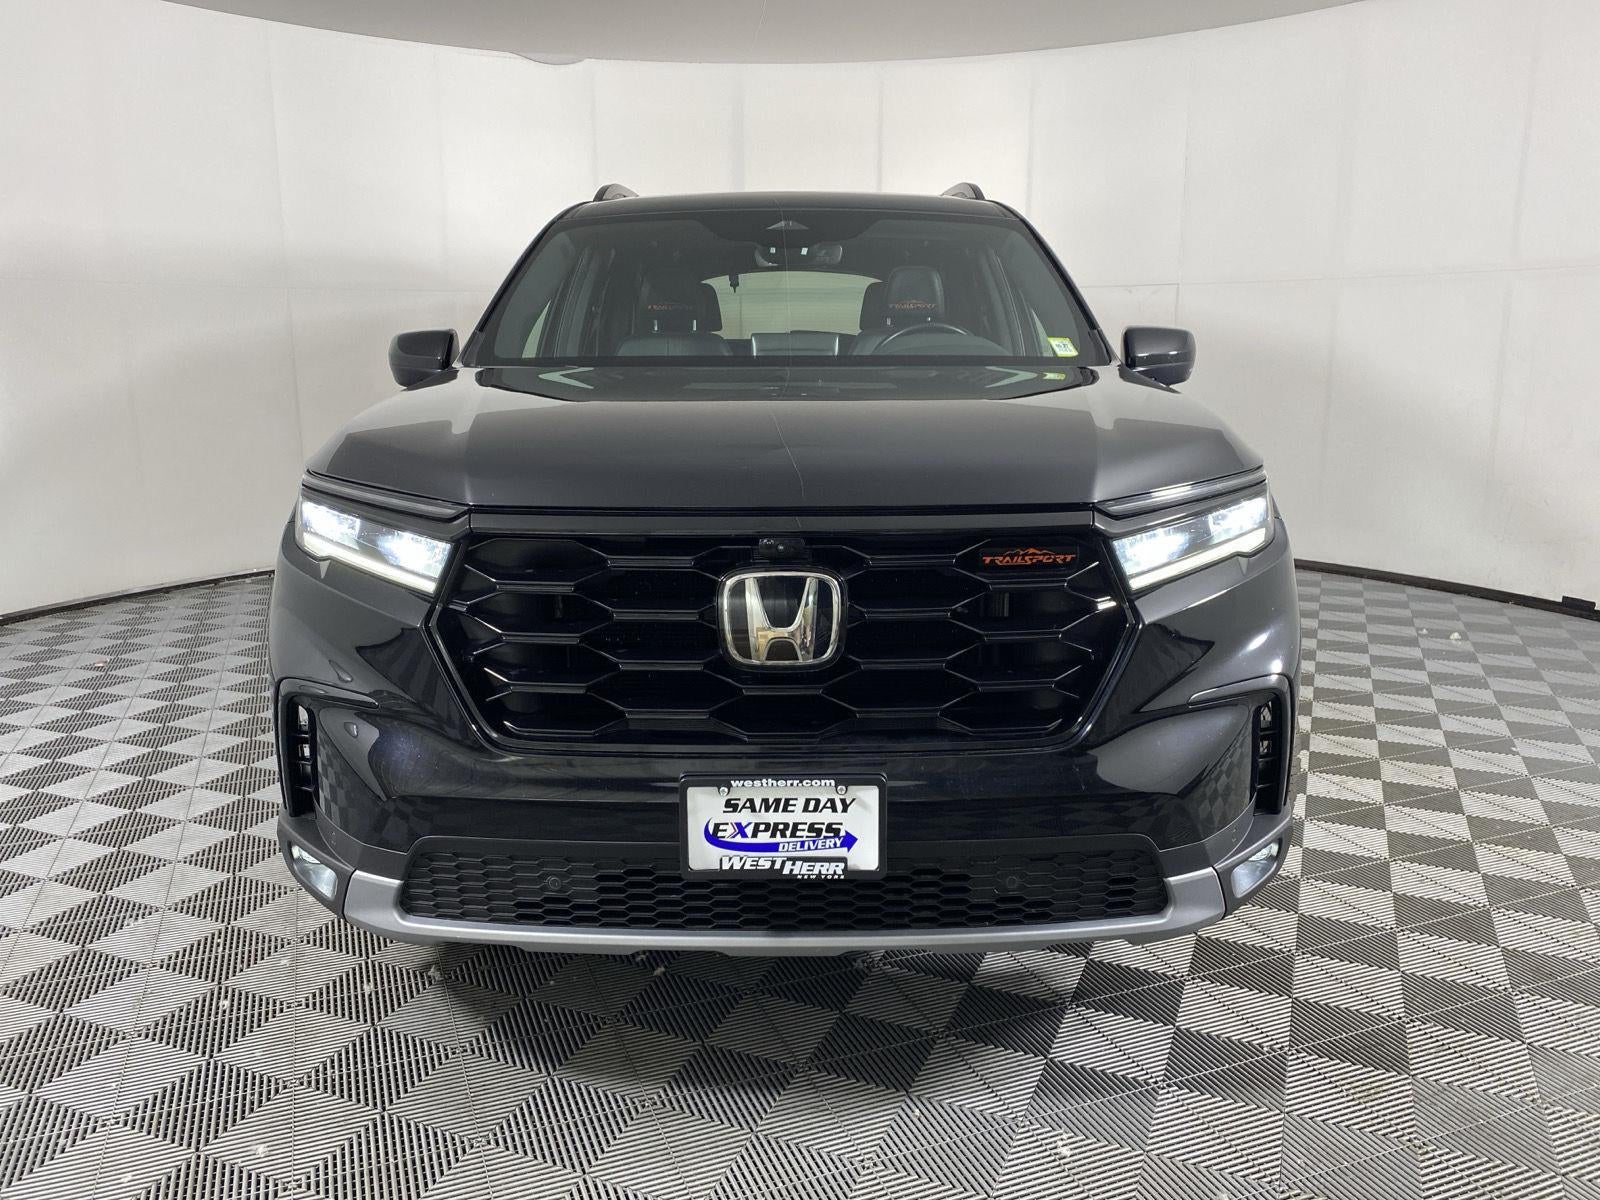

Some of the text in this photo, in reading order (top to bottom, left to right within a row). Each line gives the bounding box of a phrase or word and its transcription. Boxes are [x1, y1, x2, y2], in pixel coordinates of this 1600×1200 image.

[982, 554, 1076, 566] TRAILSPORT
[730, 778, 836, 788] westherr.com
[722, 797, 857, 814] SAME DAY
[711, 822, 843, 838] EXPRESS
[778, 838, 844, 852] DELIVERY
